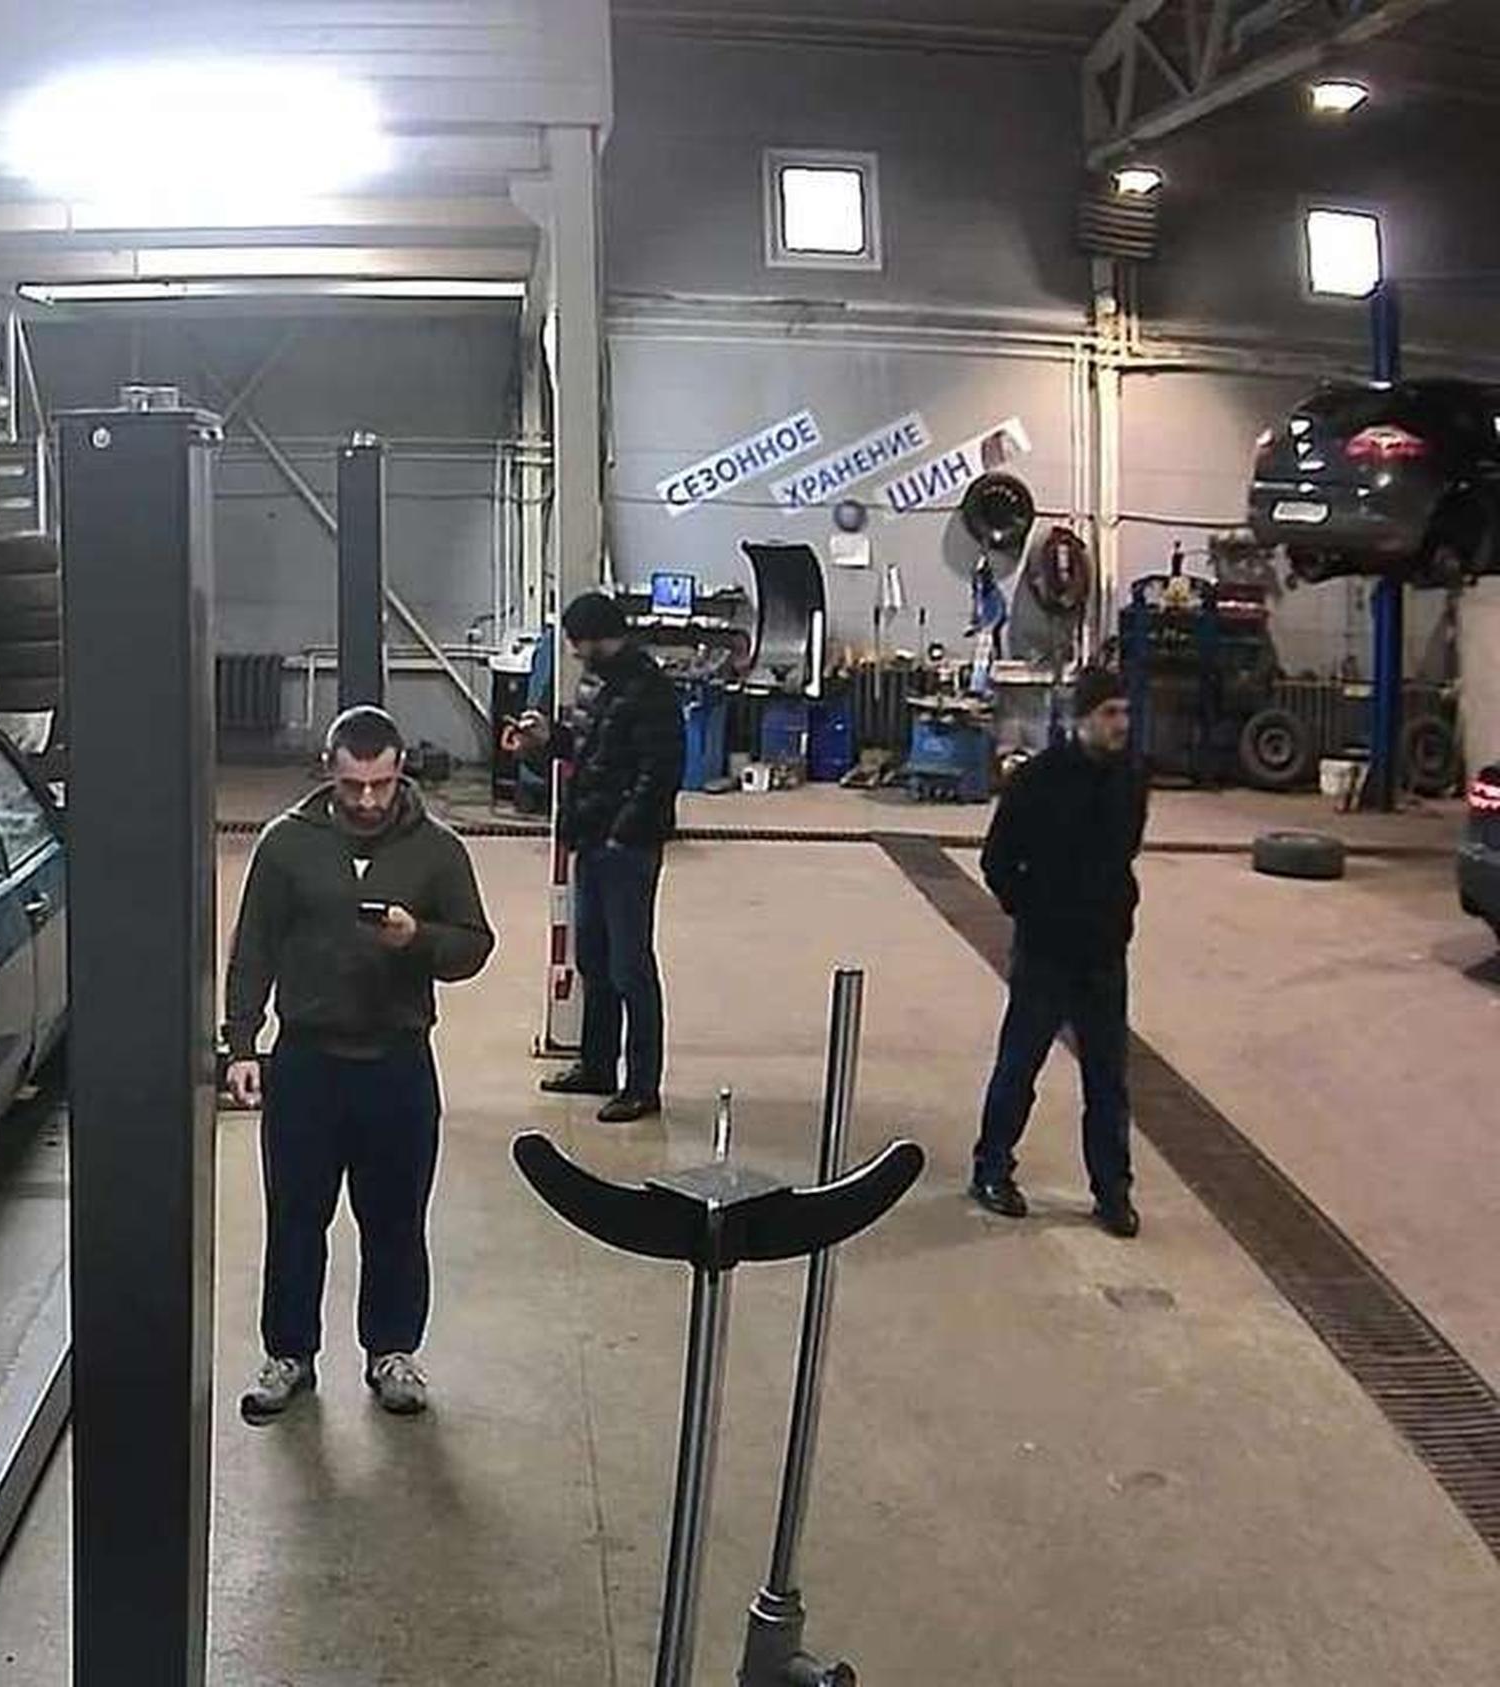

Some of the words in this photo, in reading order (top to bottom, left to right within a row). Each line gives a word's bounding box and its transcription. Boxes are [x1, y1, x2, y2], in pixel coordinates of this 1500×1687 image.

[665, 416, 817, 506] СЕЗОННОЕ
[782, 420, 923, 509] ХРАНЕНИЕ
[886, 453, 972, 513] ШИН
